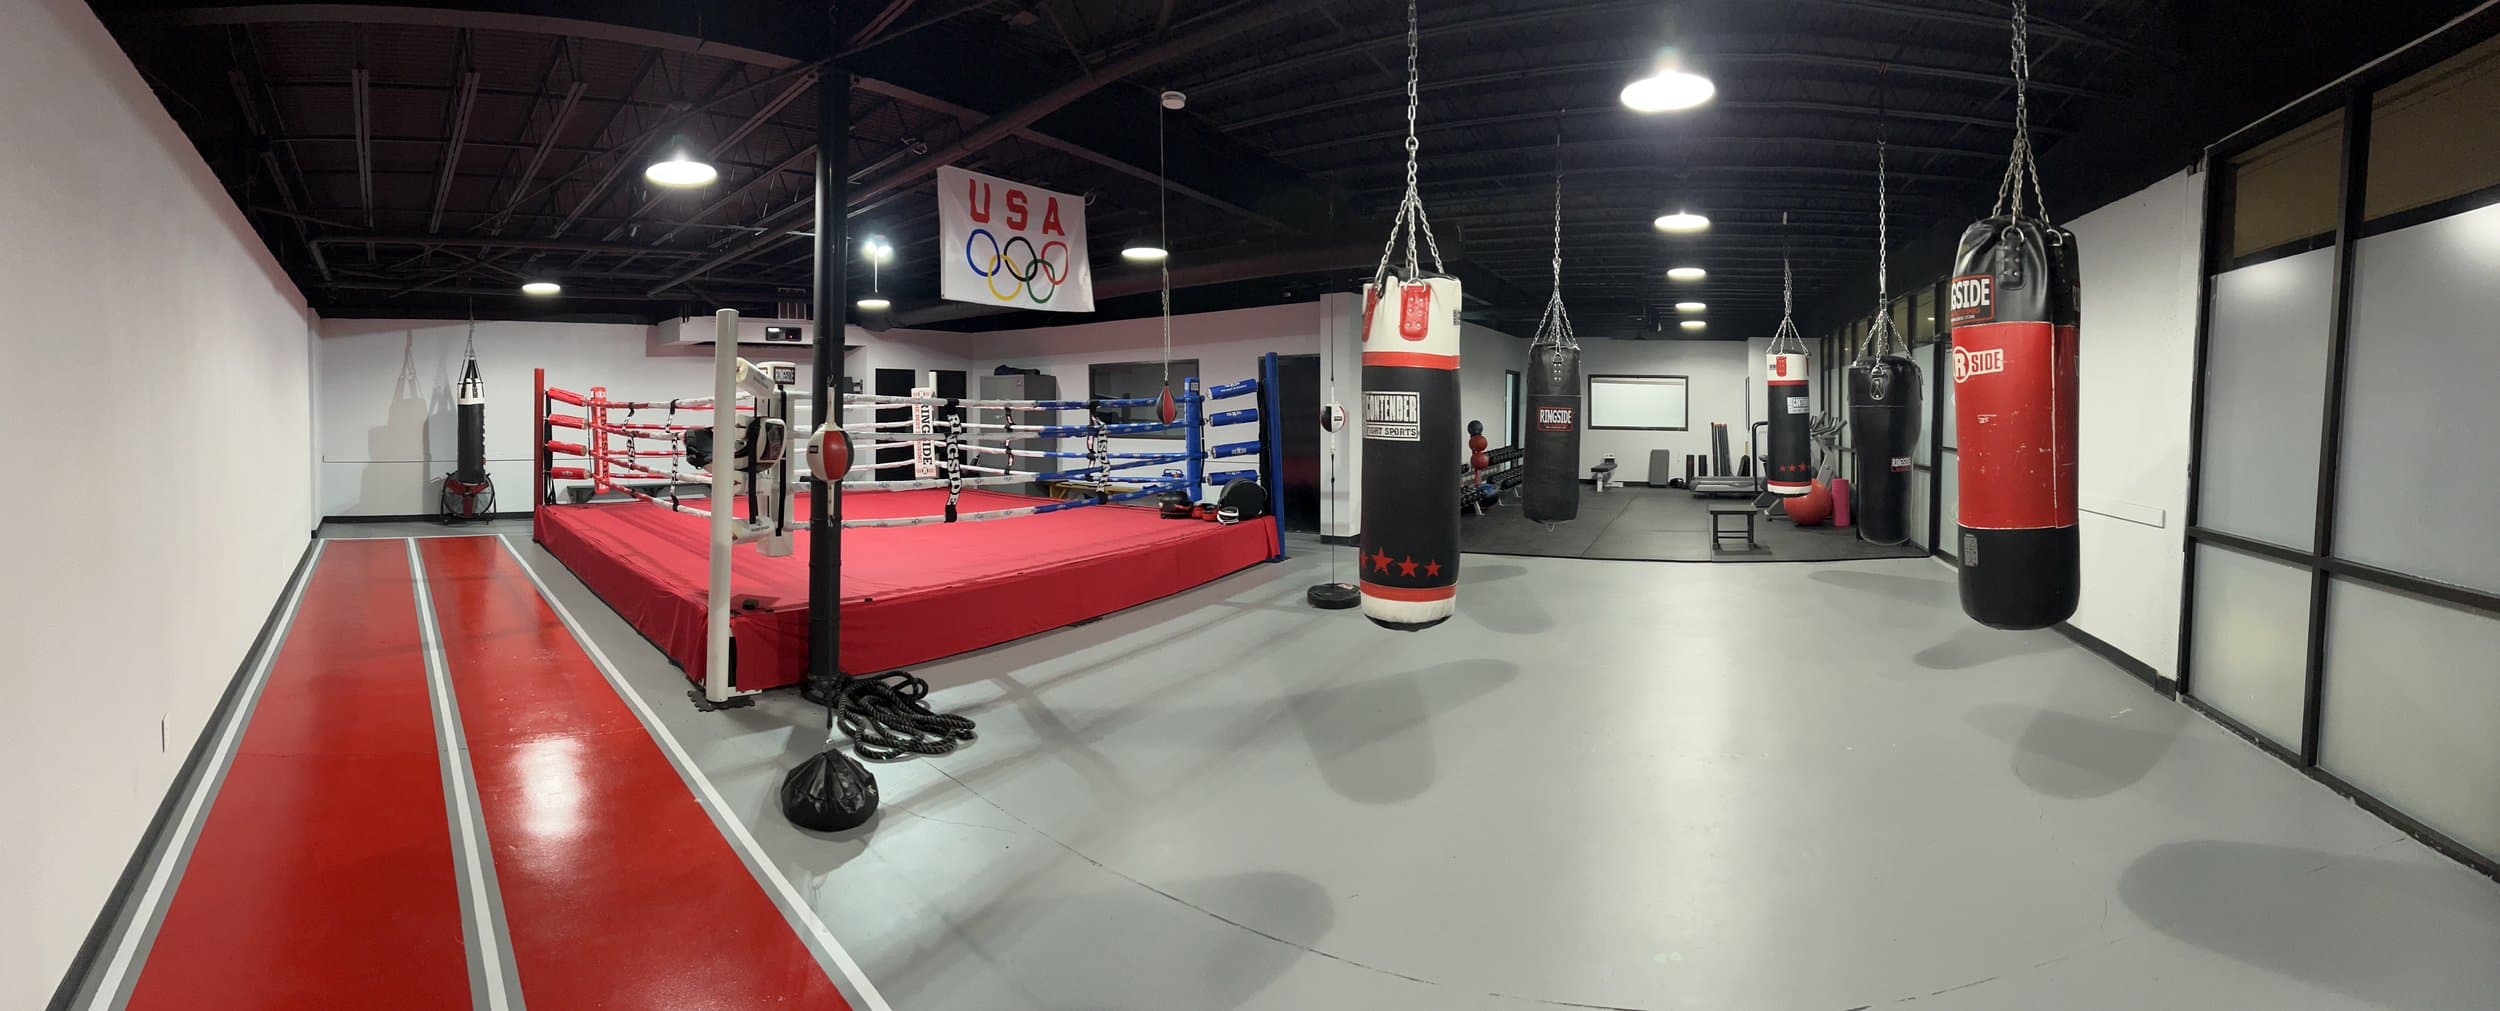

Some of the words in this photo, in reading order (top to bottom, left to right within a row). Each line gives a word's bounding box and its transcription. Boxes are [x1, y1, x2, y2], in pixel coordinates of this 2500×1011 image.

[969, 178, 1065, 236] USA
[1540, 409, 1572, 424] RINGSIDE
[1385, 427, 1417, 436] SPORTS
